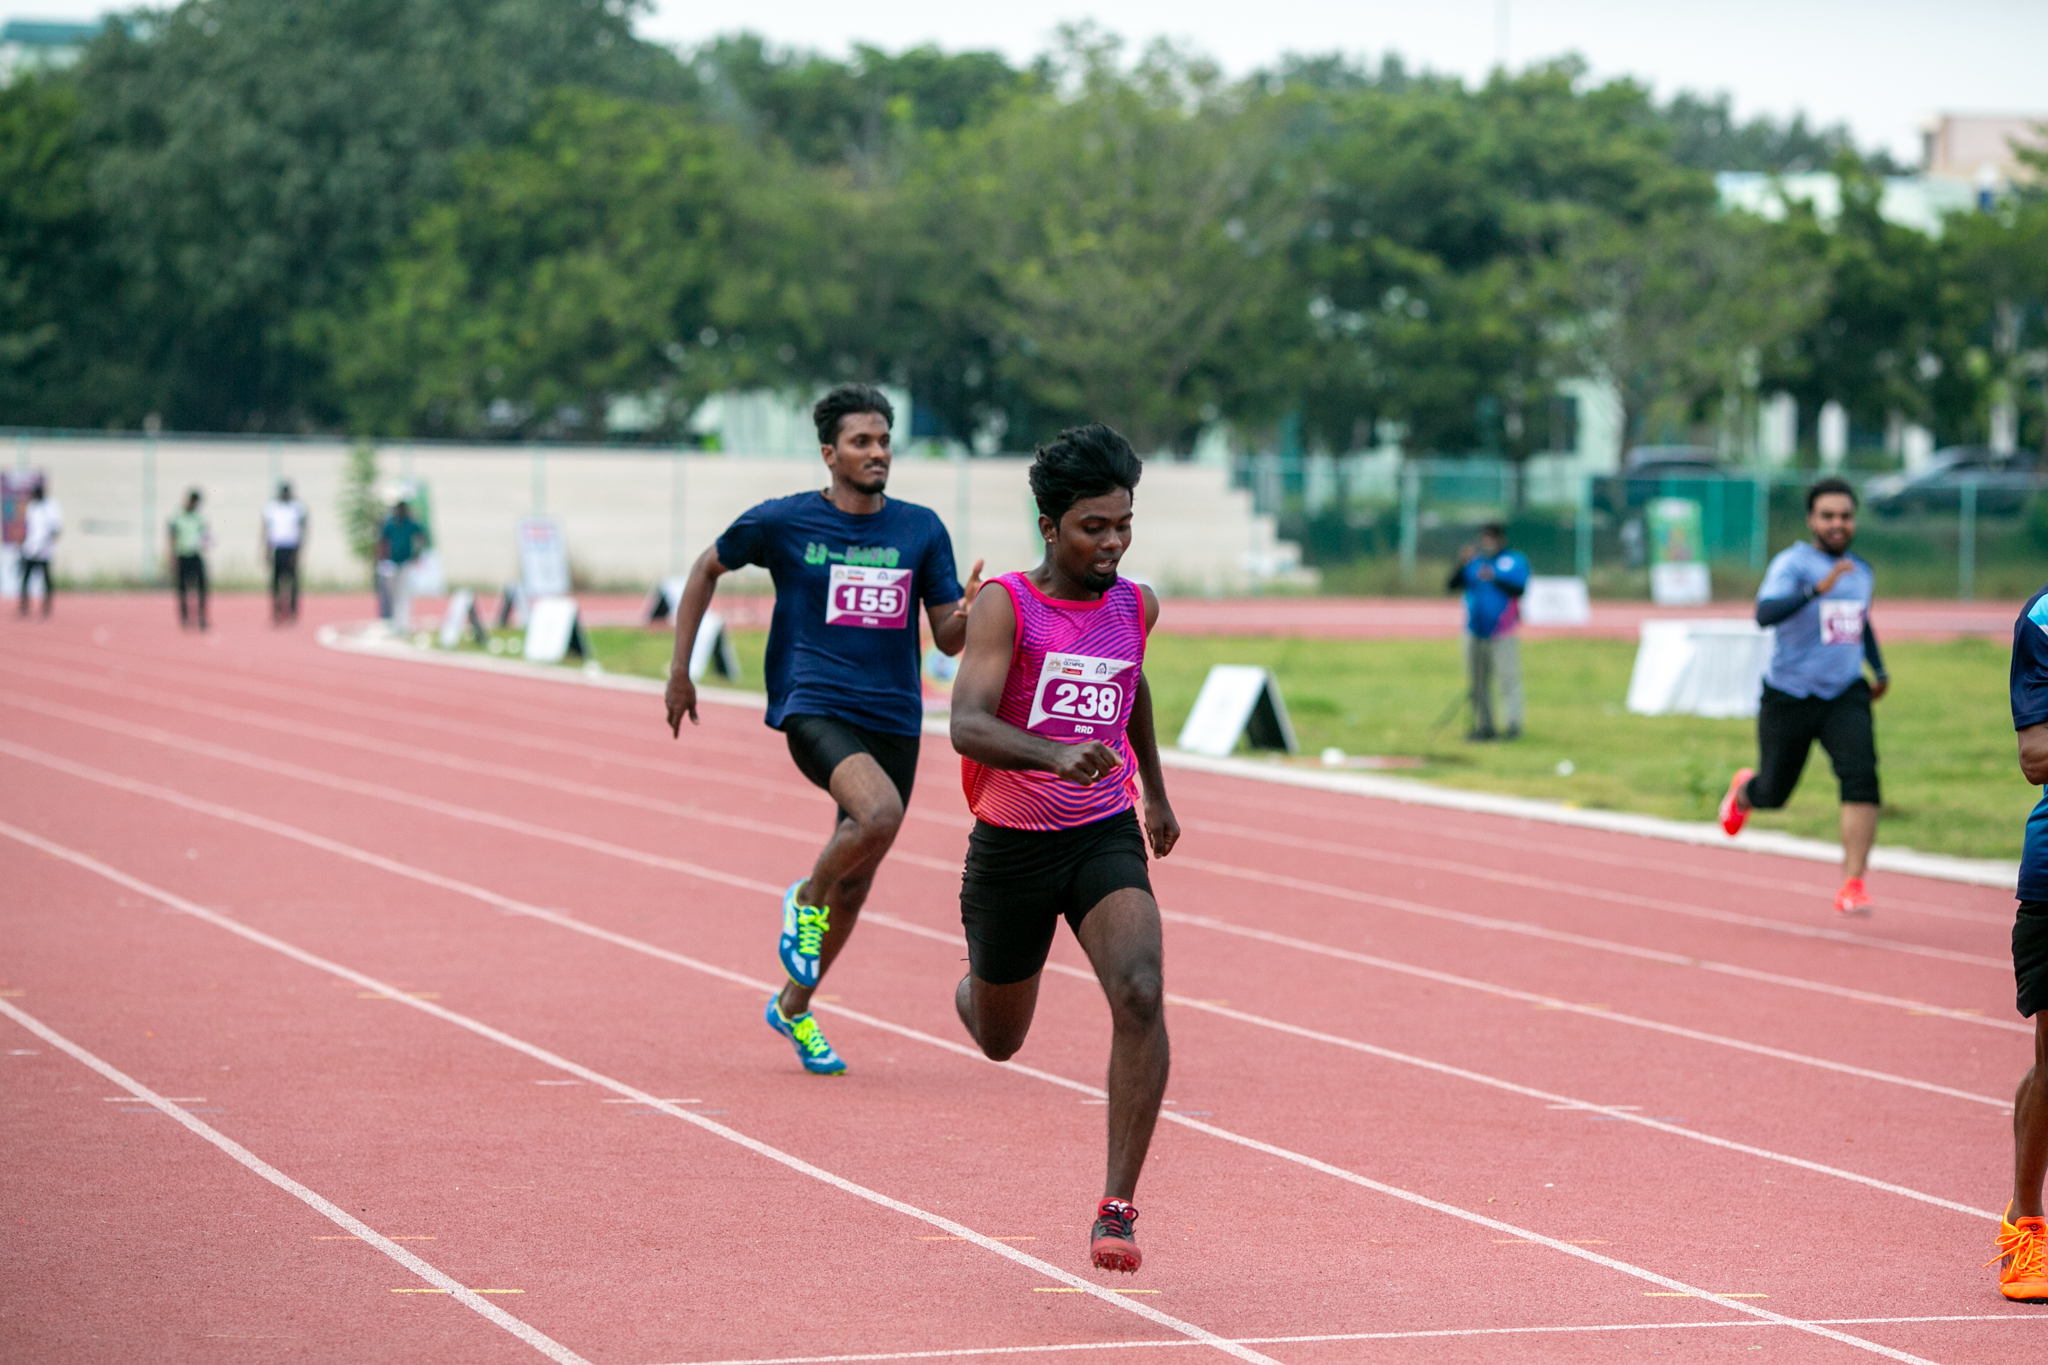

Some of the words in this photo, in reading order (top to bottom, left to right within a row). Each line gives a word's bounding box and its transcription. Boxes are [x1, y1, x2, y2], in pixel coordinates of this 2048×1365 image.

[842, 586, 899, 613] 155
[1051, 683, 1116, 719] 238
[1074, 724, 1094, 734] RRD
